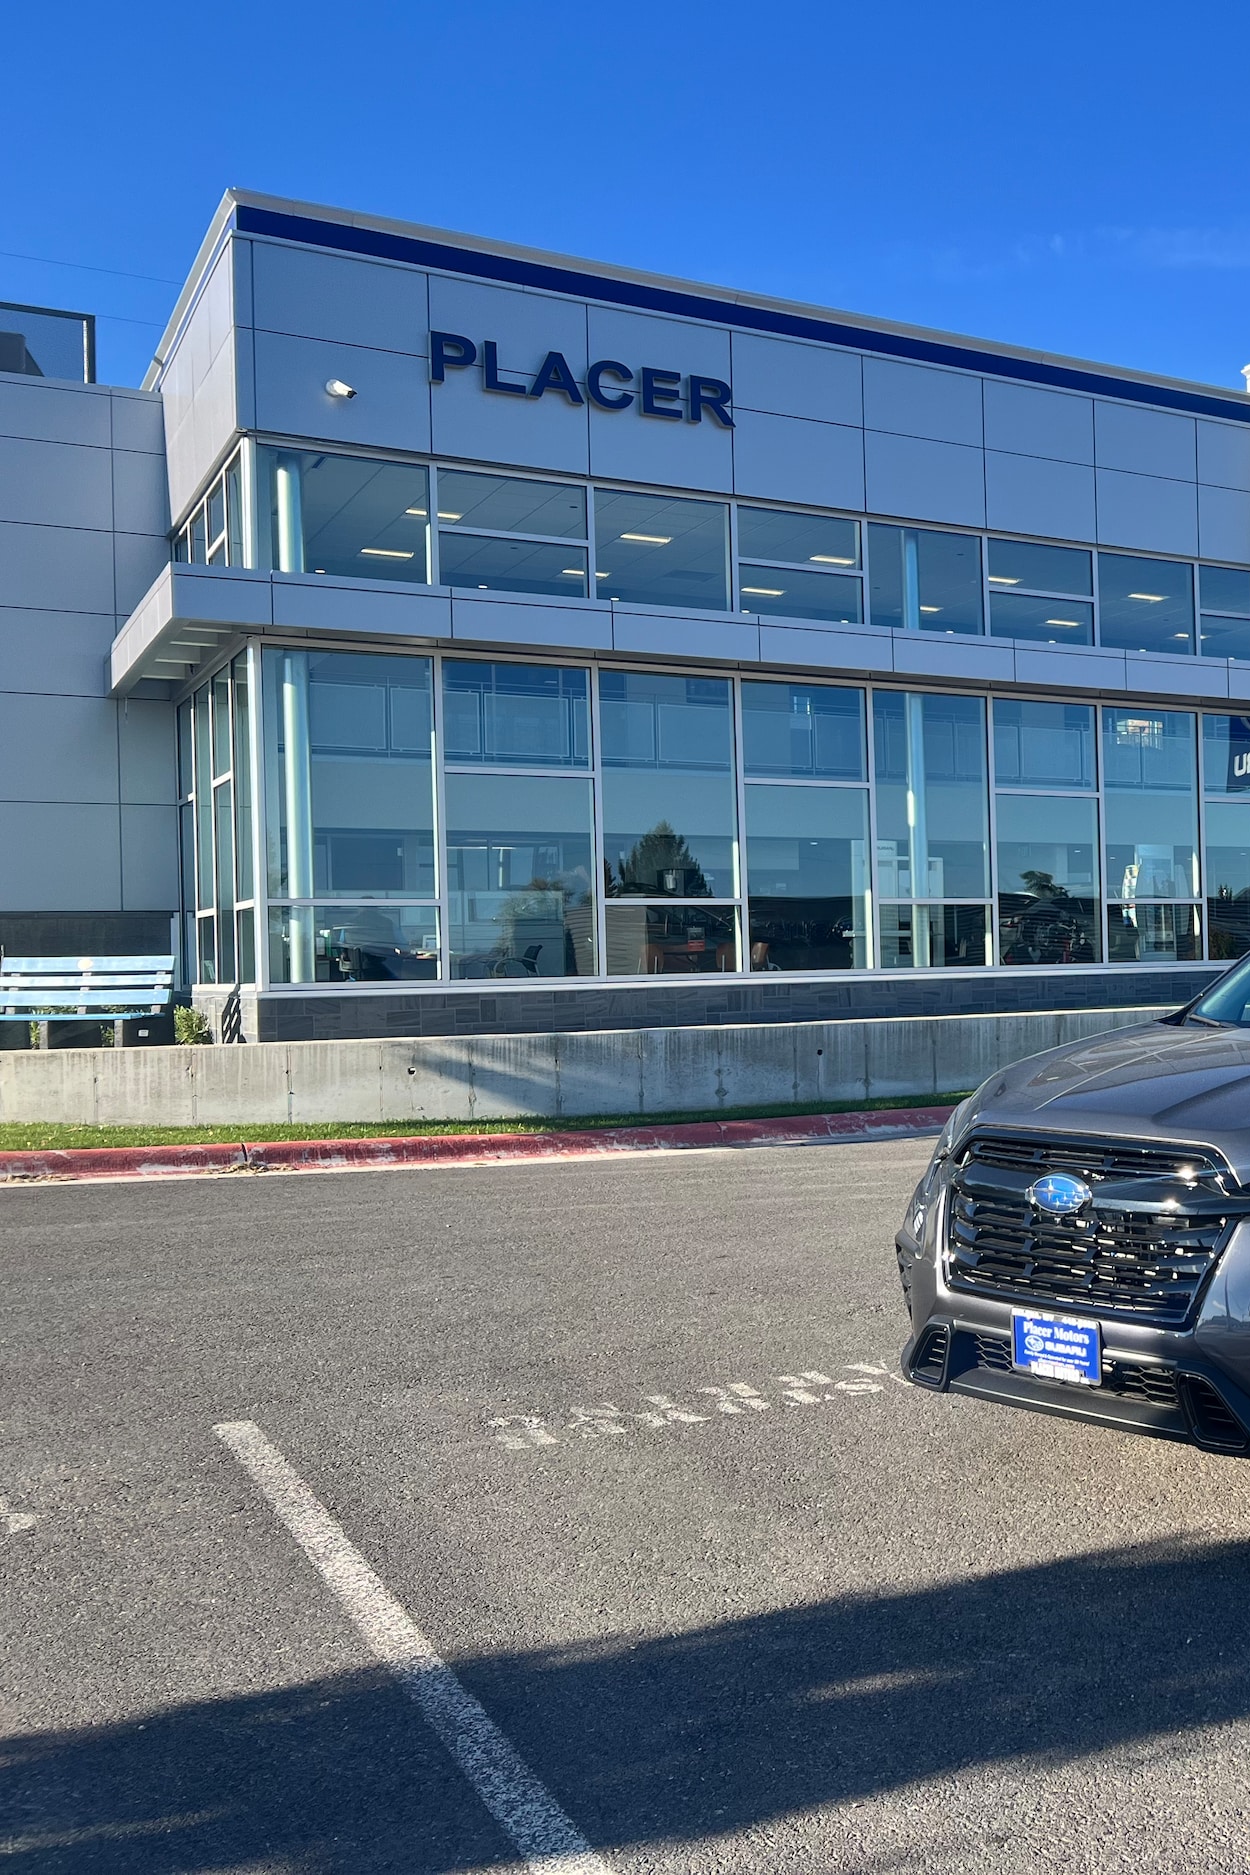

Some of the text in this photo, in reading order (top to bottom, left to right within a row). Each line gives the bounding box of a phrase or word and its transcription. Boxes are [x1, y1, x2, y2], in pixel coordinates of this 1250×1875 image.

[429, 330, 736, 428] PLACER
[1023, 1321, 1052, 1338] Placer
[1054, 1327, 1089, 1344] Motors
[1045, 1342, 1087, 1357] SUBARU
